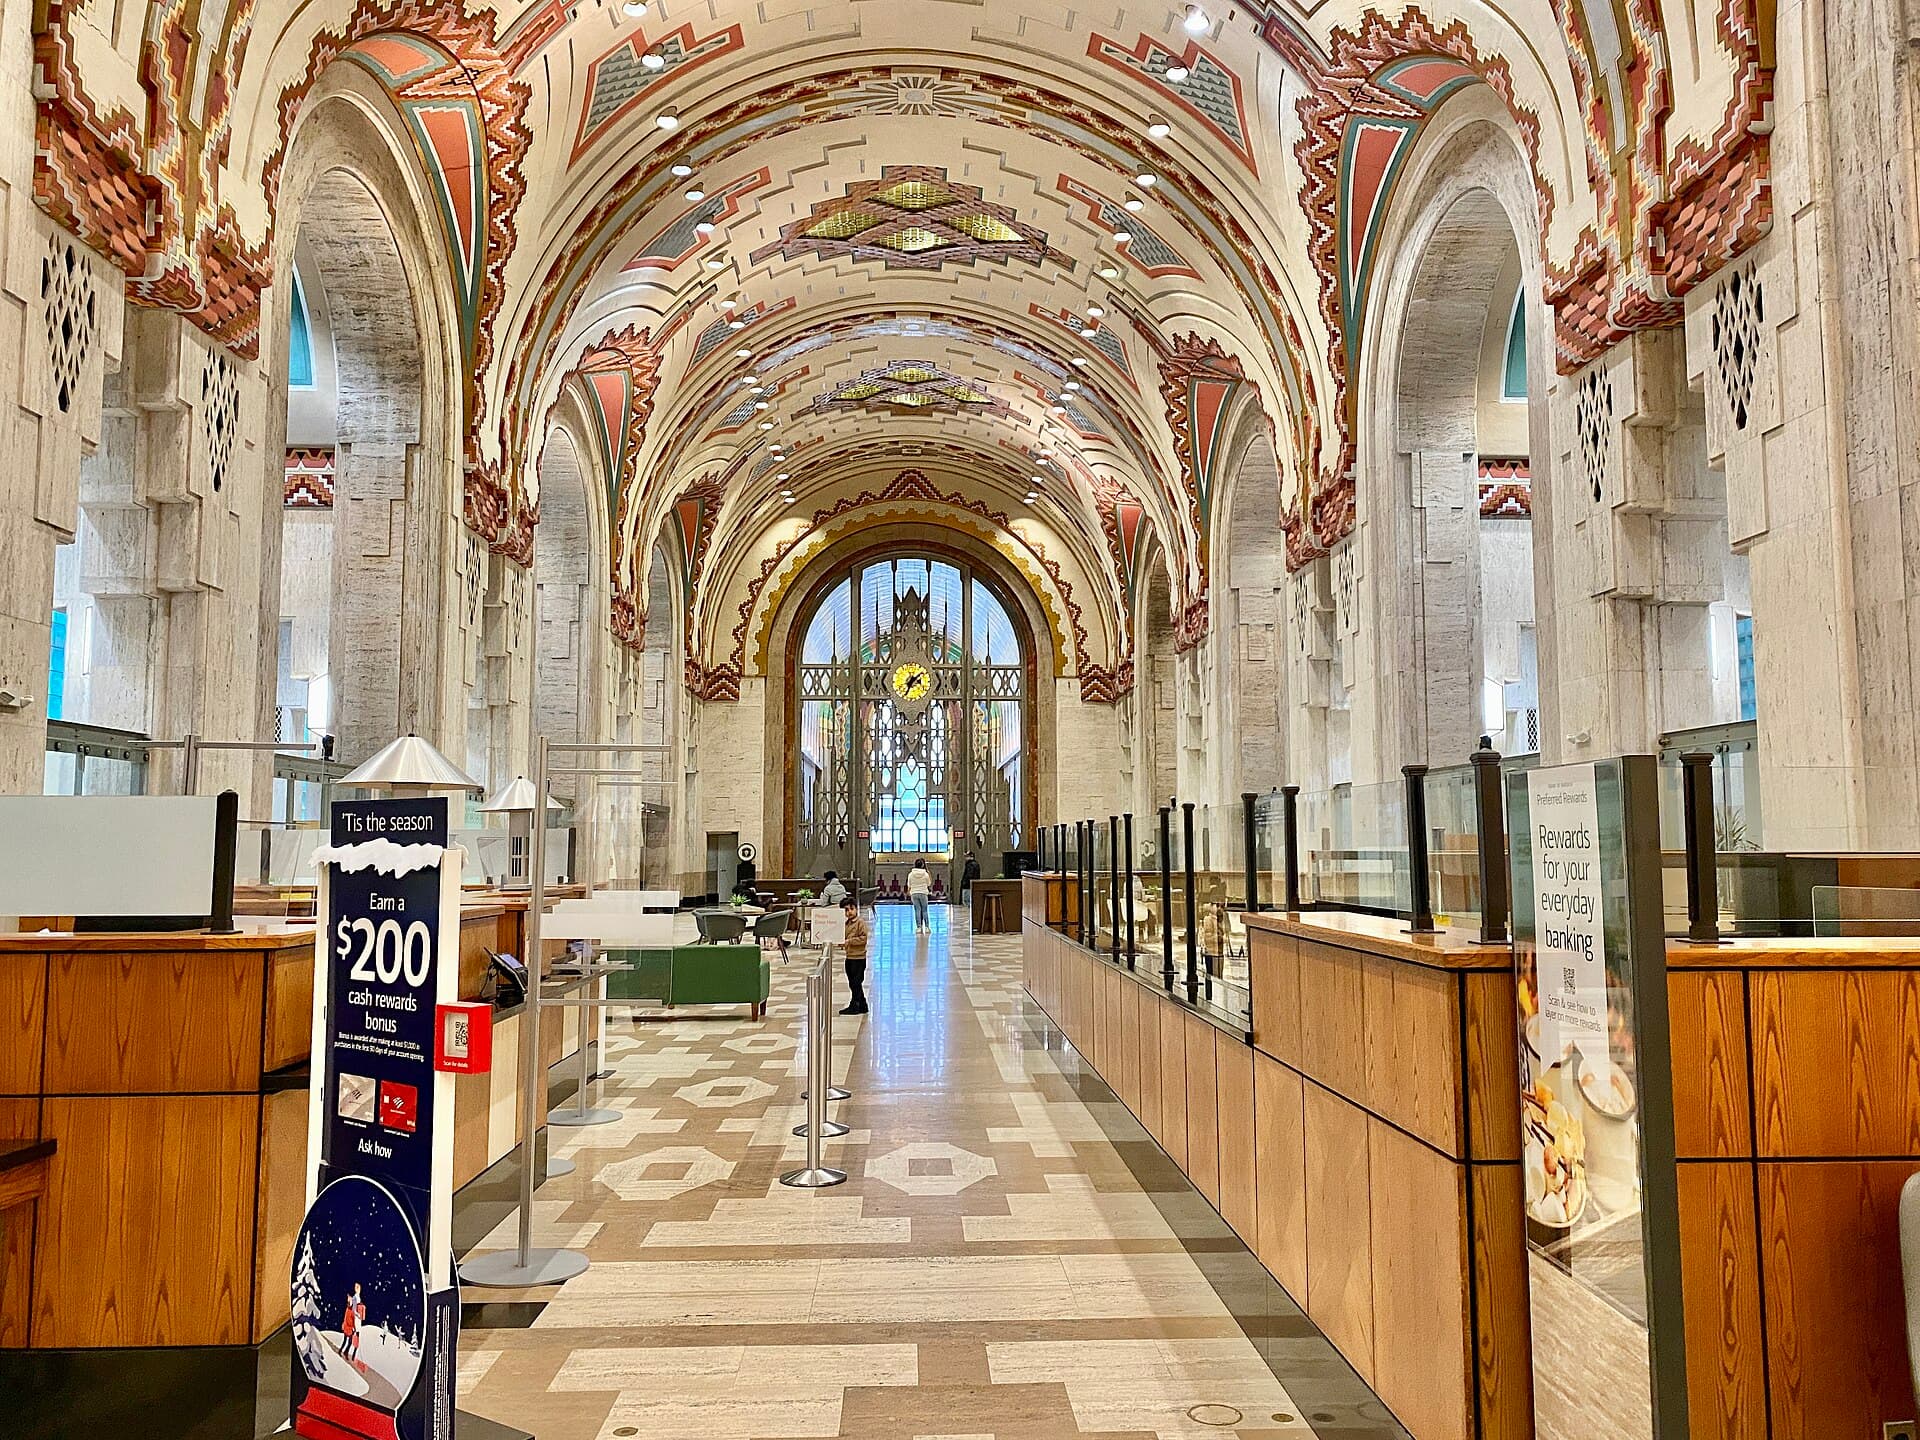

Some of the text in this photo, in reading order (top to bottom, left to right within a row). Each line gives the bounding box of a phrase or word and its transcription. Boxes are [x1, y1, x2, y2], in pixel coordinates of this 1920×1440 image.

[1537, 791, 1588, 805] Preferred Rewards
[366, 812, 386, 831] the
[389, 815, 433, 832] season
[1539, 822, 1590, 849] Rewards
[1543, 854, 1590, 886] for your
[370, 893, 404, 911] Earn a
[1542, 888, 1594, 922] everyday
[336, 915, 430, 987] $200
[1545, 922, 1594, 962] banking
[348, 988, 417, 1012] cash rewards
[1548, 994, 1560, 1006] Scan
[1567, 1001, 1576, 1011] see
[1577, 1000, 1588, 1014] how
[1590, 1006, 1596, 1016] to
[366, 1012, 397, 1032] bonus
[1558, 1012, 1564, 1022] on
[1565, 1014, 1578, 1026] more
[1580, 1018, 1601, 1032] rewards
[358, 1138, 392, 1158] Ask how
